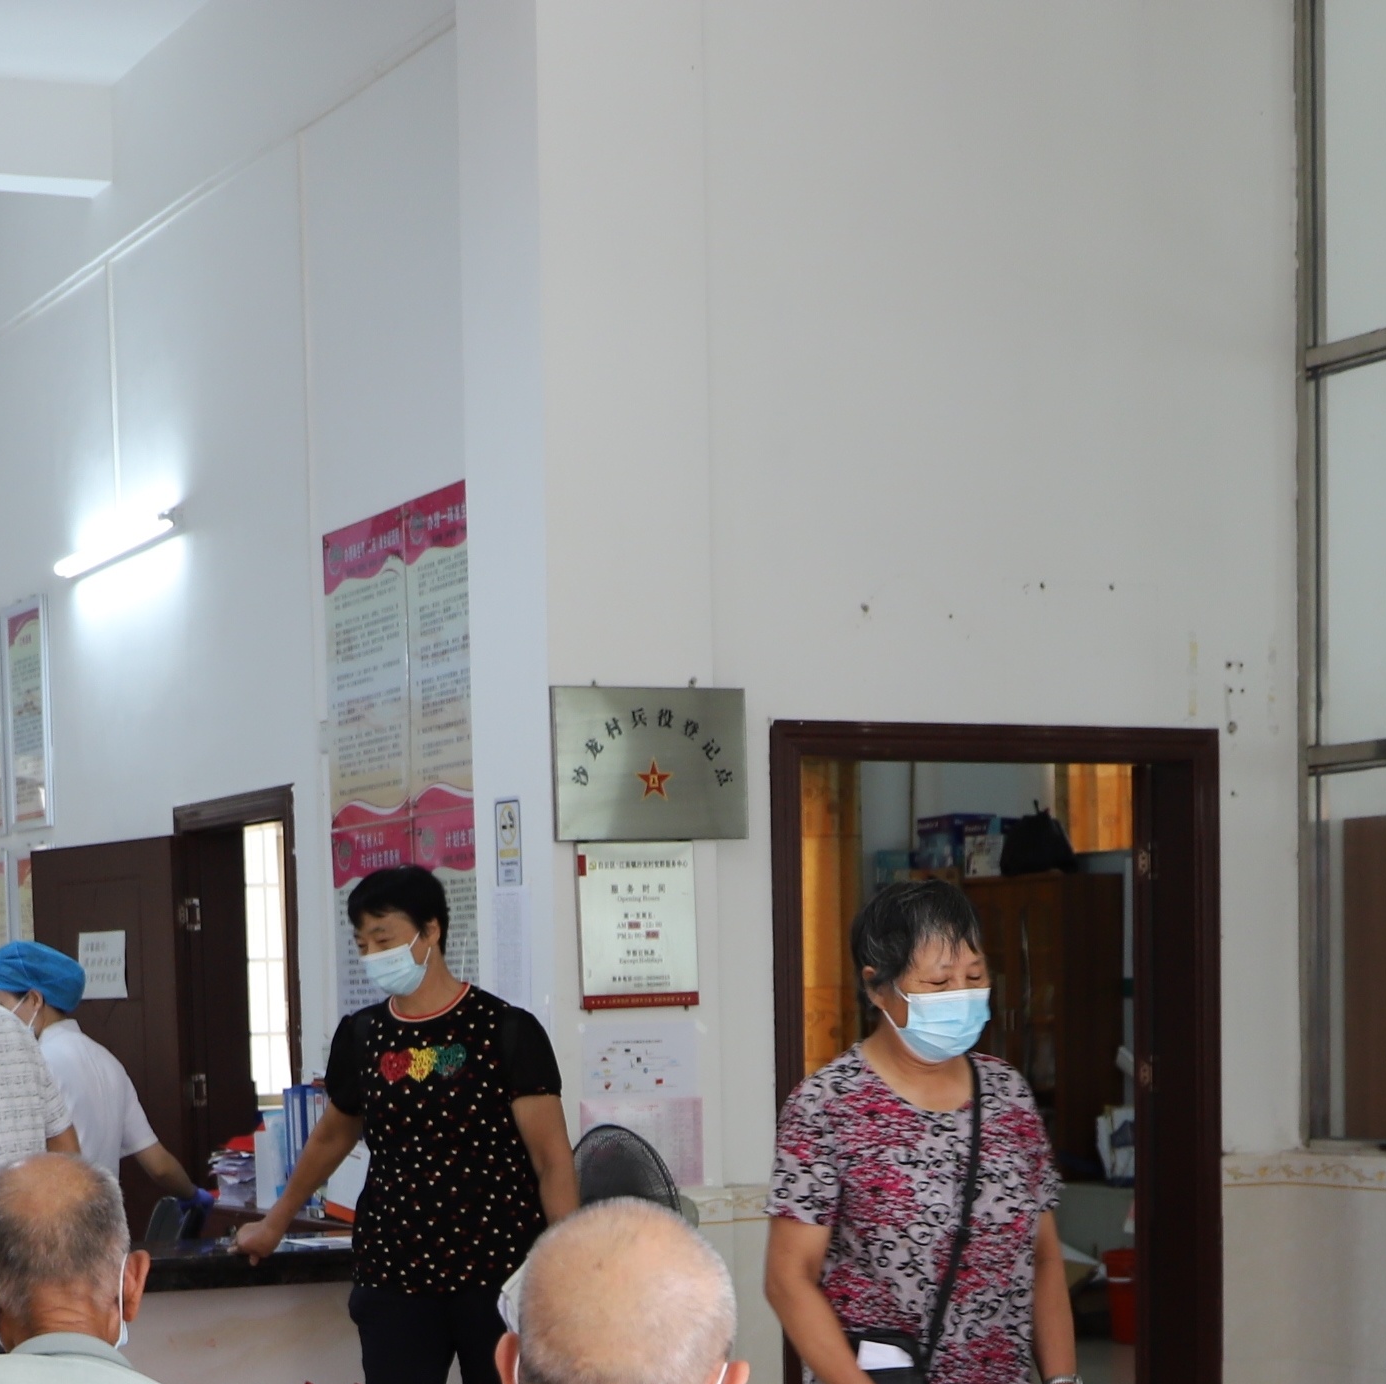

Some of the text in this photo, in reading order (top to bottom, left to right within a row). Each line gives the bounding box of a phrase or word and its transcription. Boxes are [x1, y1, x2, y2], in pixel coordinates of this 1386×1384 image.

[571, 707, 734, 788] 沙龙村兵役登记点
